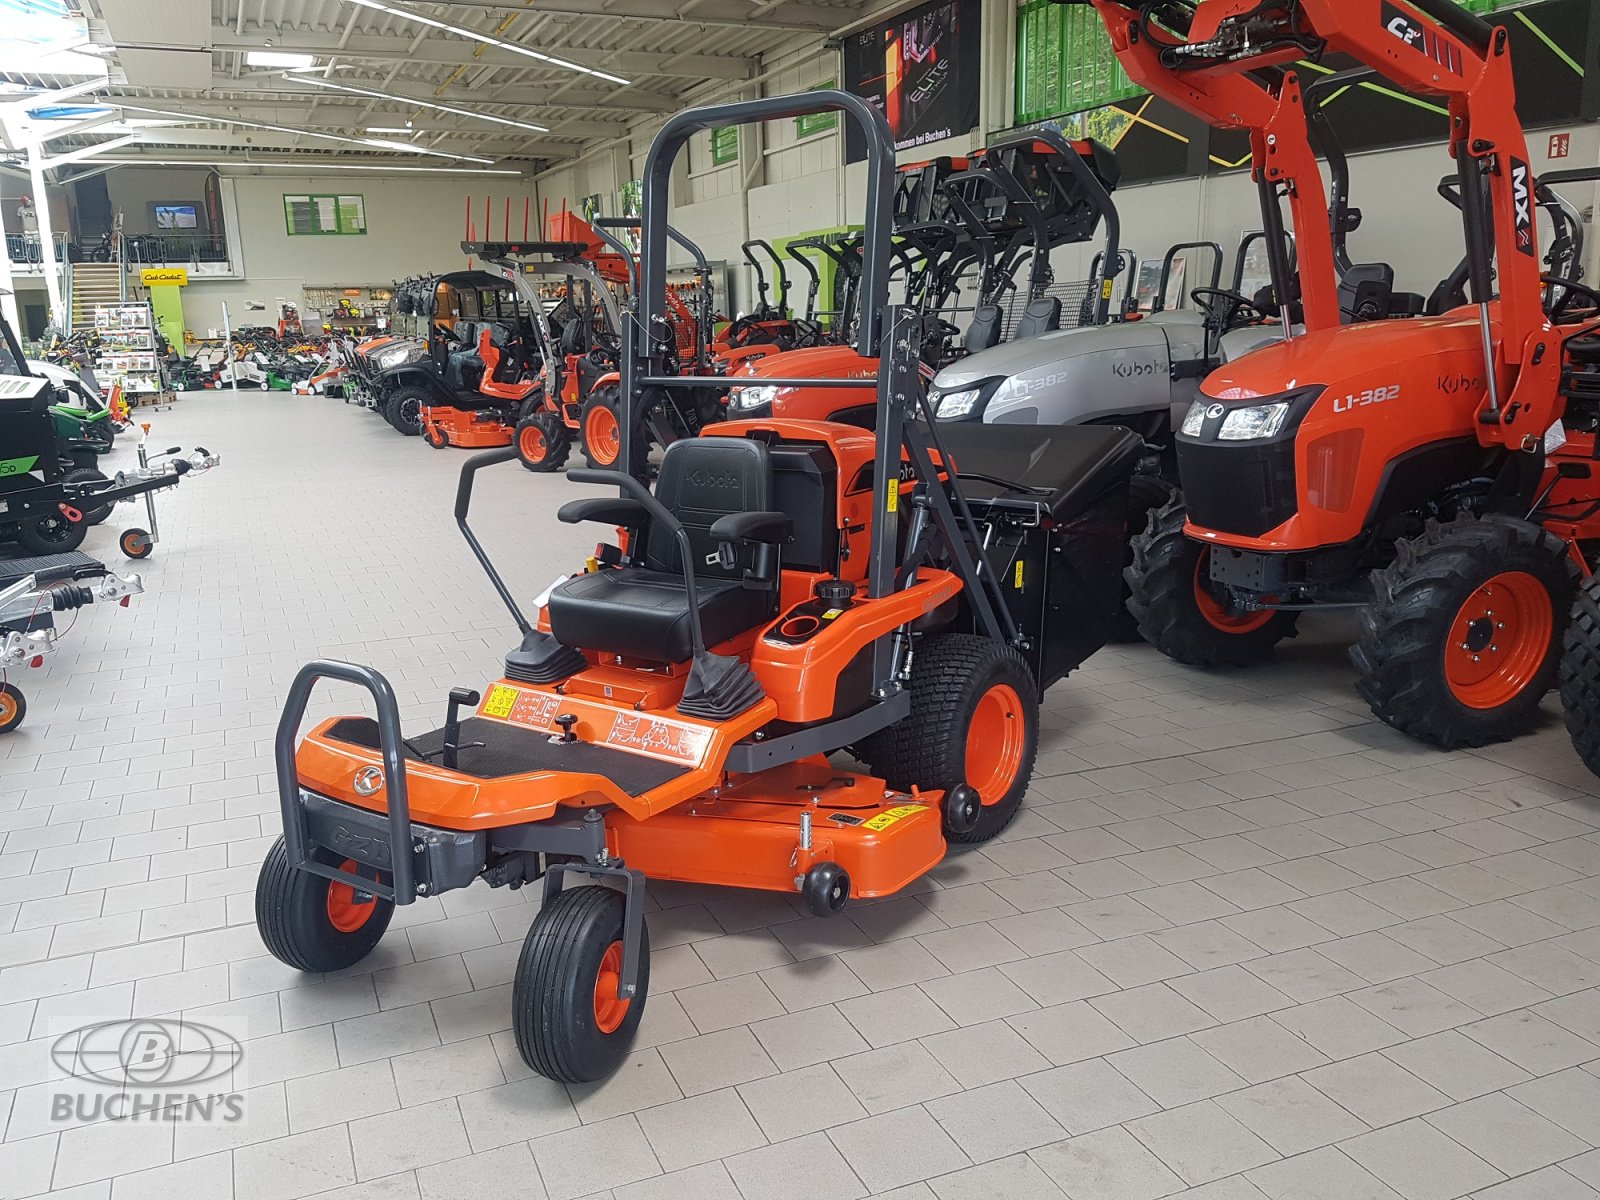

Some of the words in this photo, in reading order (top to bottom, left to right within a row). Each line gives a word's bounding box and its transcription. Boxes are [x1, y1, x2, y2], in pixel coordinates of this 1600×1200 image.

[915, 133, 925, 145] bei
[1512, 165, 1530, 227] MX
[848, 369, 878, 379] Kubo
